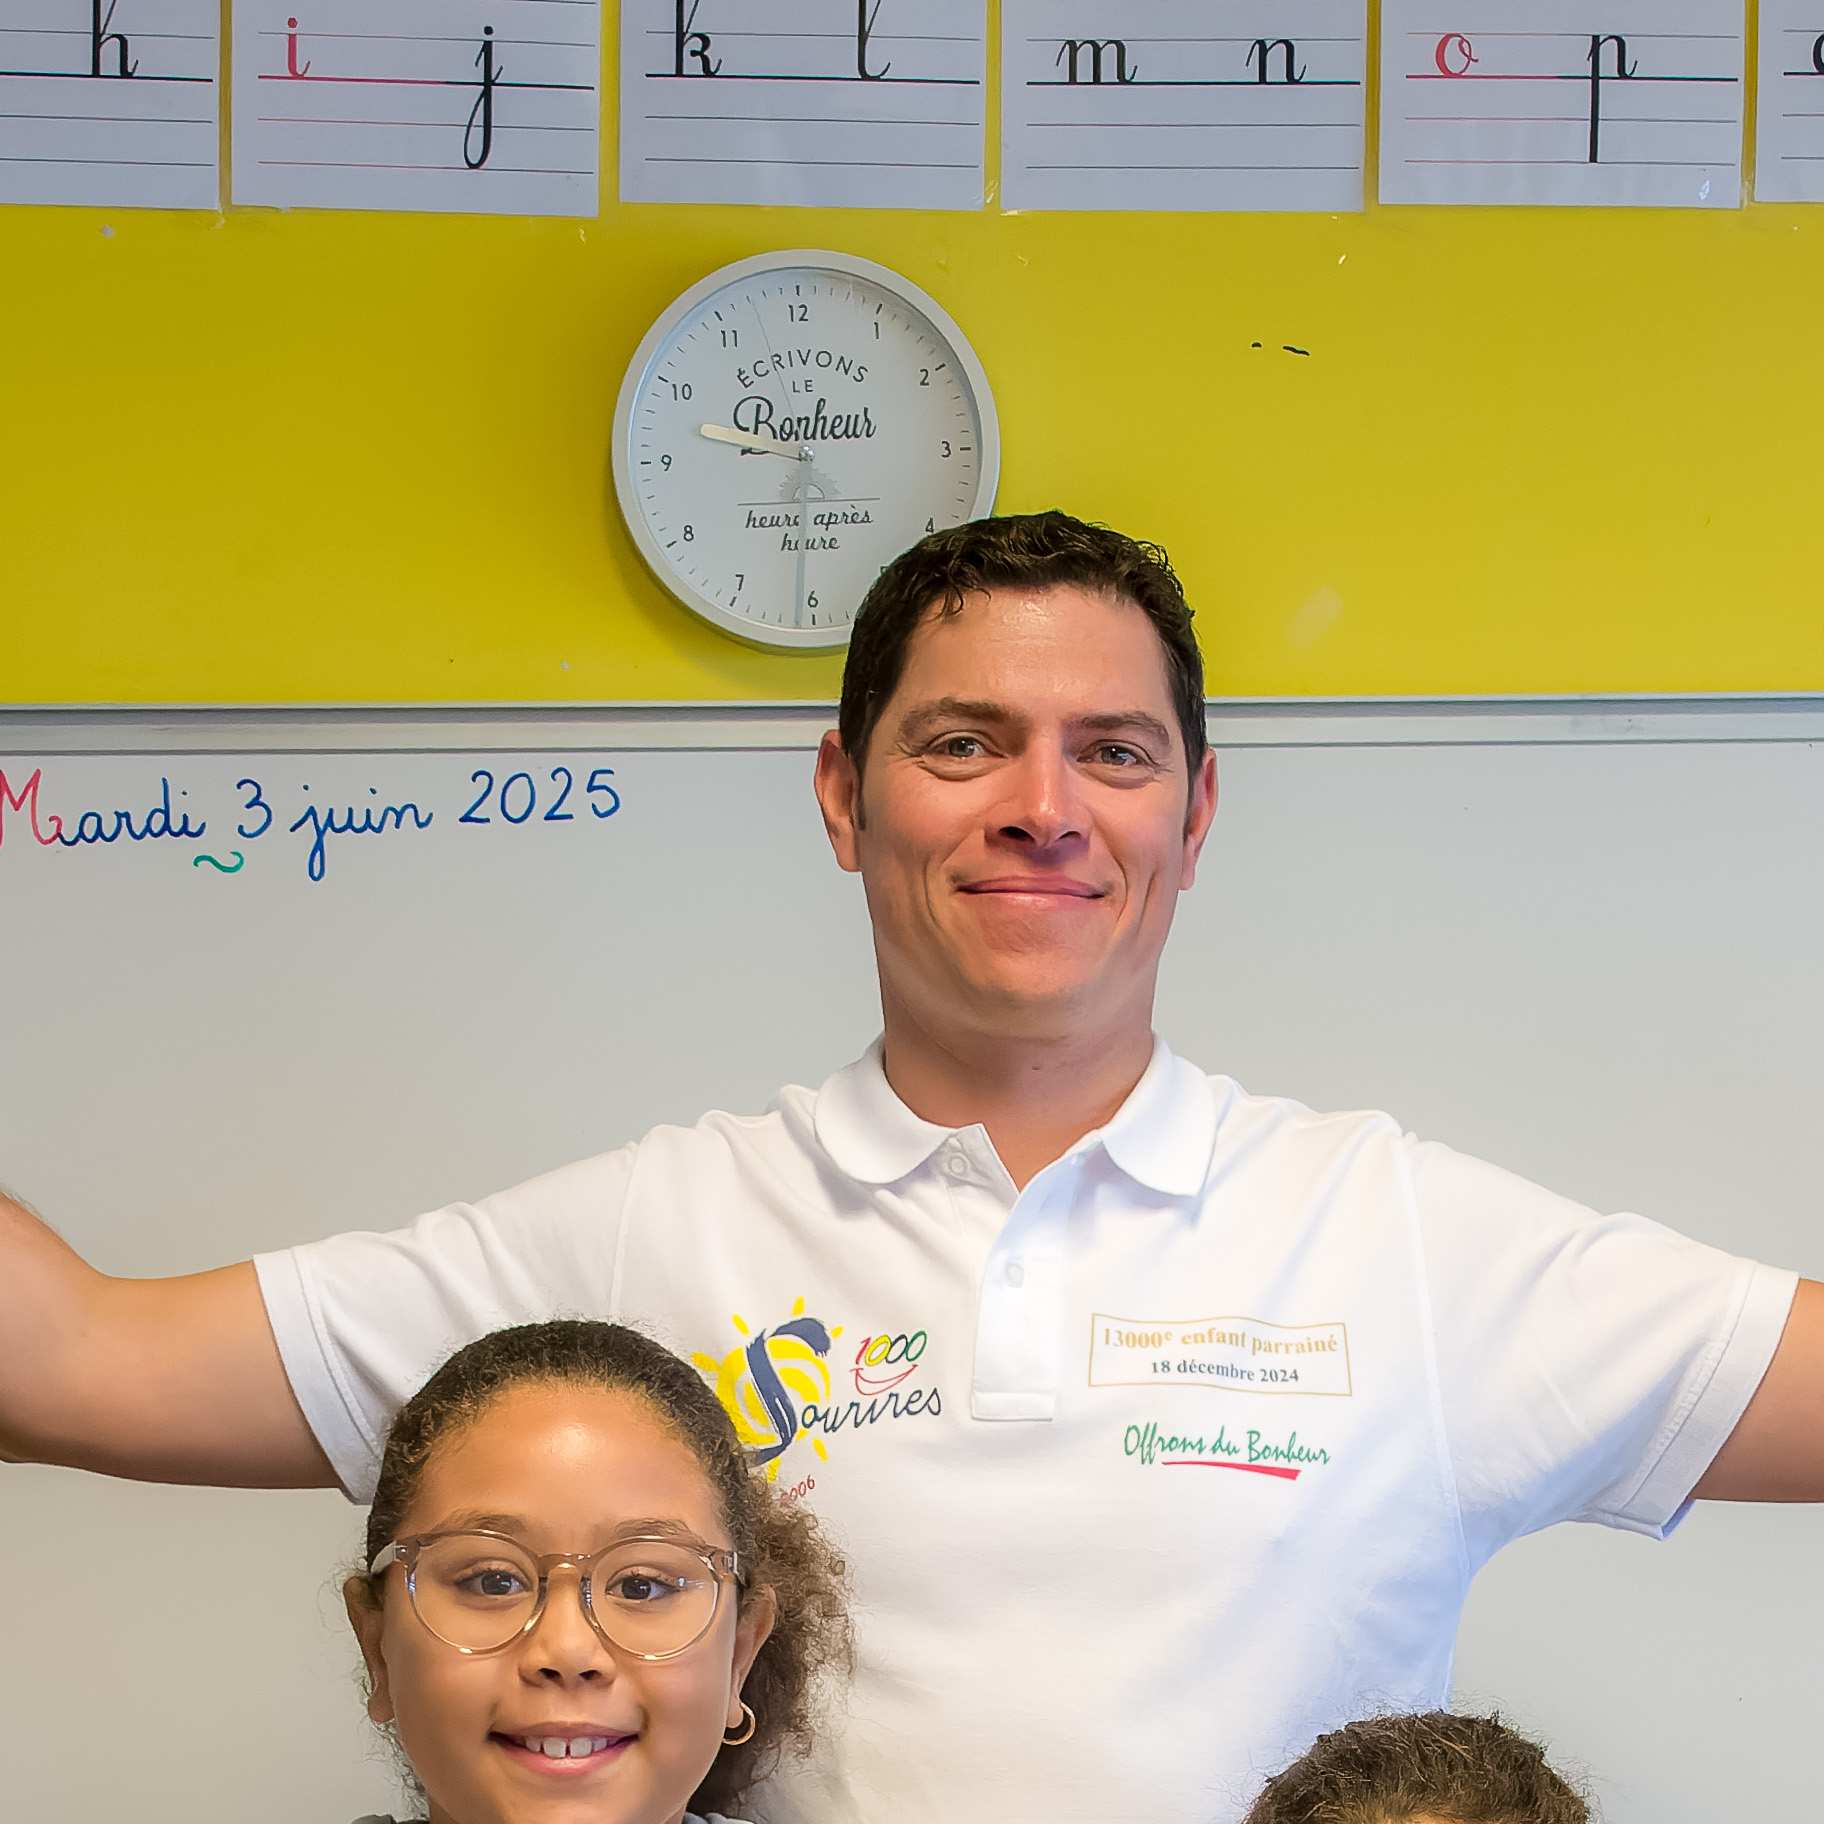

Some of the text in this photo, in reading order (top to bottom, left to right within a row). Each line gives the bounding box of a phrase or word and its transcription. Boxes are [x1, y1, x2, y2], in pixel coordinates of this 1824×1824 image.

[1057, 37, 1307, 85] m n
[286, 17, 503, 169] i j
[1435, 32, 1637, 163] o p
[788, 304, 809, 322] 12
[720, 329, 739, 348] 11
[874, 322, 879, 340] 1
[736, 348, 869, 389] ÉCRIVONS
[919, 369, 930, 386] 2
[672, 383, 692, 400] 10
[792, 379, 814, 394] LE
[733, 396, 876, 450] Bonheur
[941, 440, 952, 457] 3
[661, 454, 672, 472] 9
[813, 505, 874, 531] après
[925, 518, 934, 534] 4
[683, 525, 694, 542] 8
[735, 574, 745, 591] 7
[807, 591, 819, 608] 6
[236, 779, 274, 838] 3
[290, 782, 432, 881] juin
[459, 768, 623, 824] 2025
[855, 1330, 927, 1366] 1000
[1180, 1327, 1245, 1347] enfant
[1252, 1334, 1338, 1356] parrainé
[1151, 1359, 1299, 1382] 18 décembre 2024
[1124, 1422, 1331, 1465] Offrons du Bonheur
